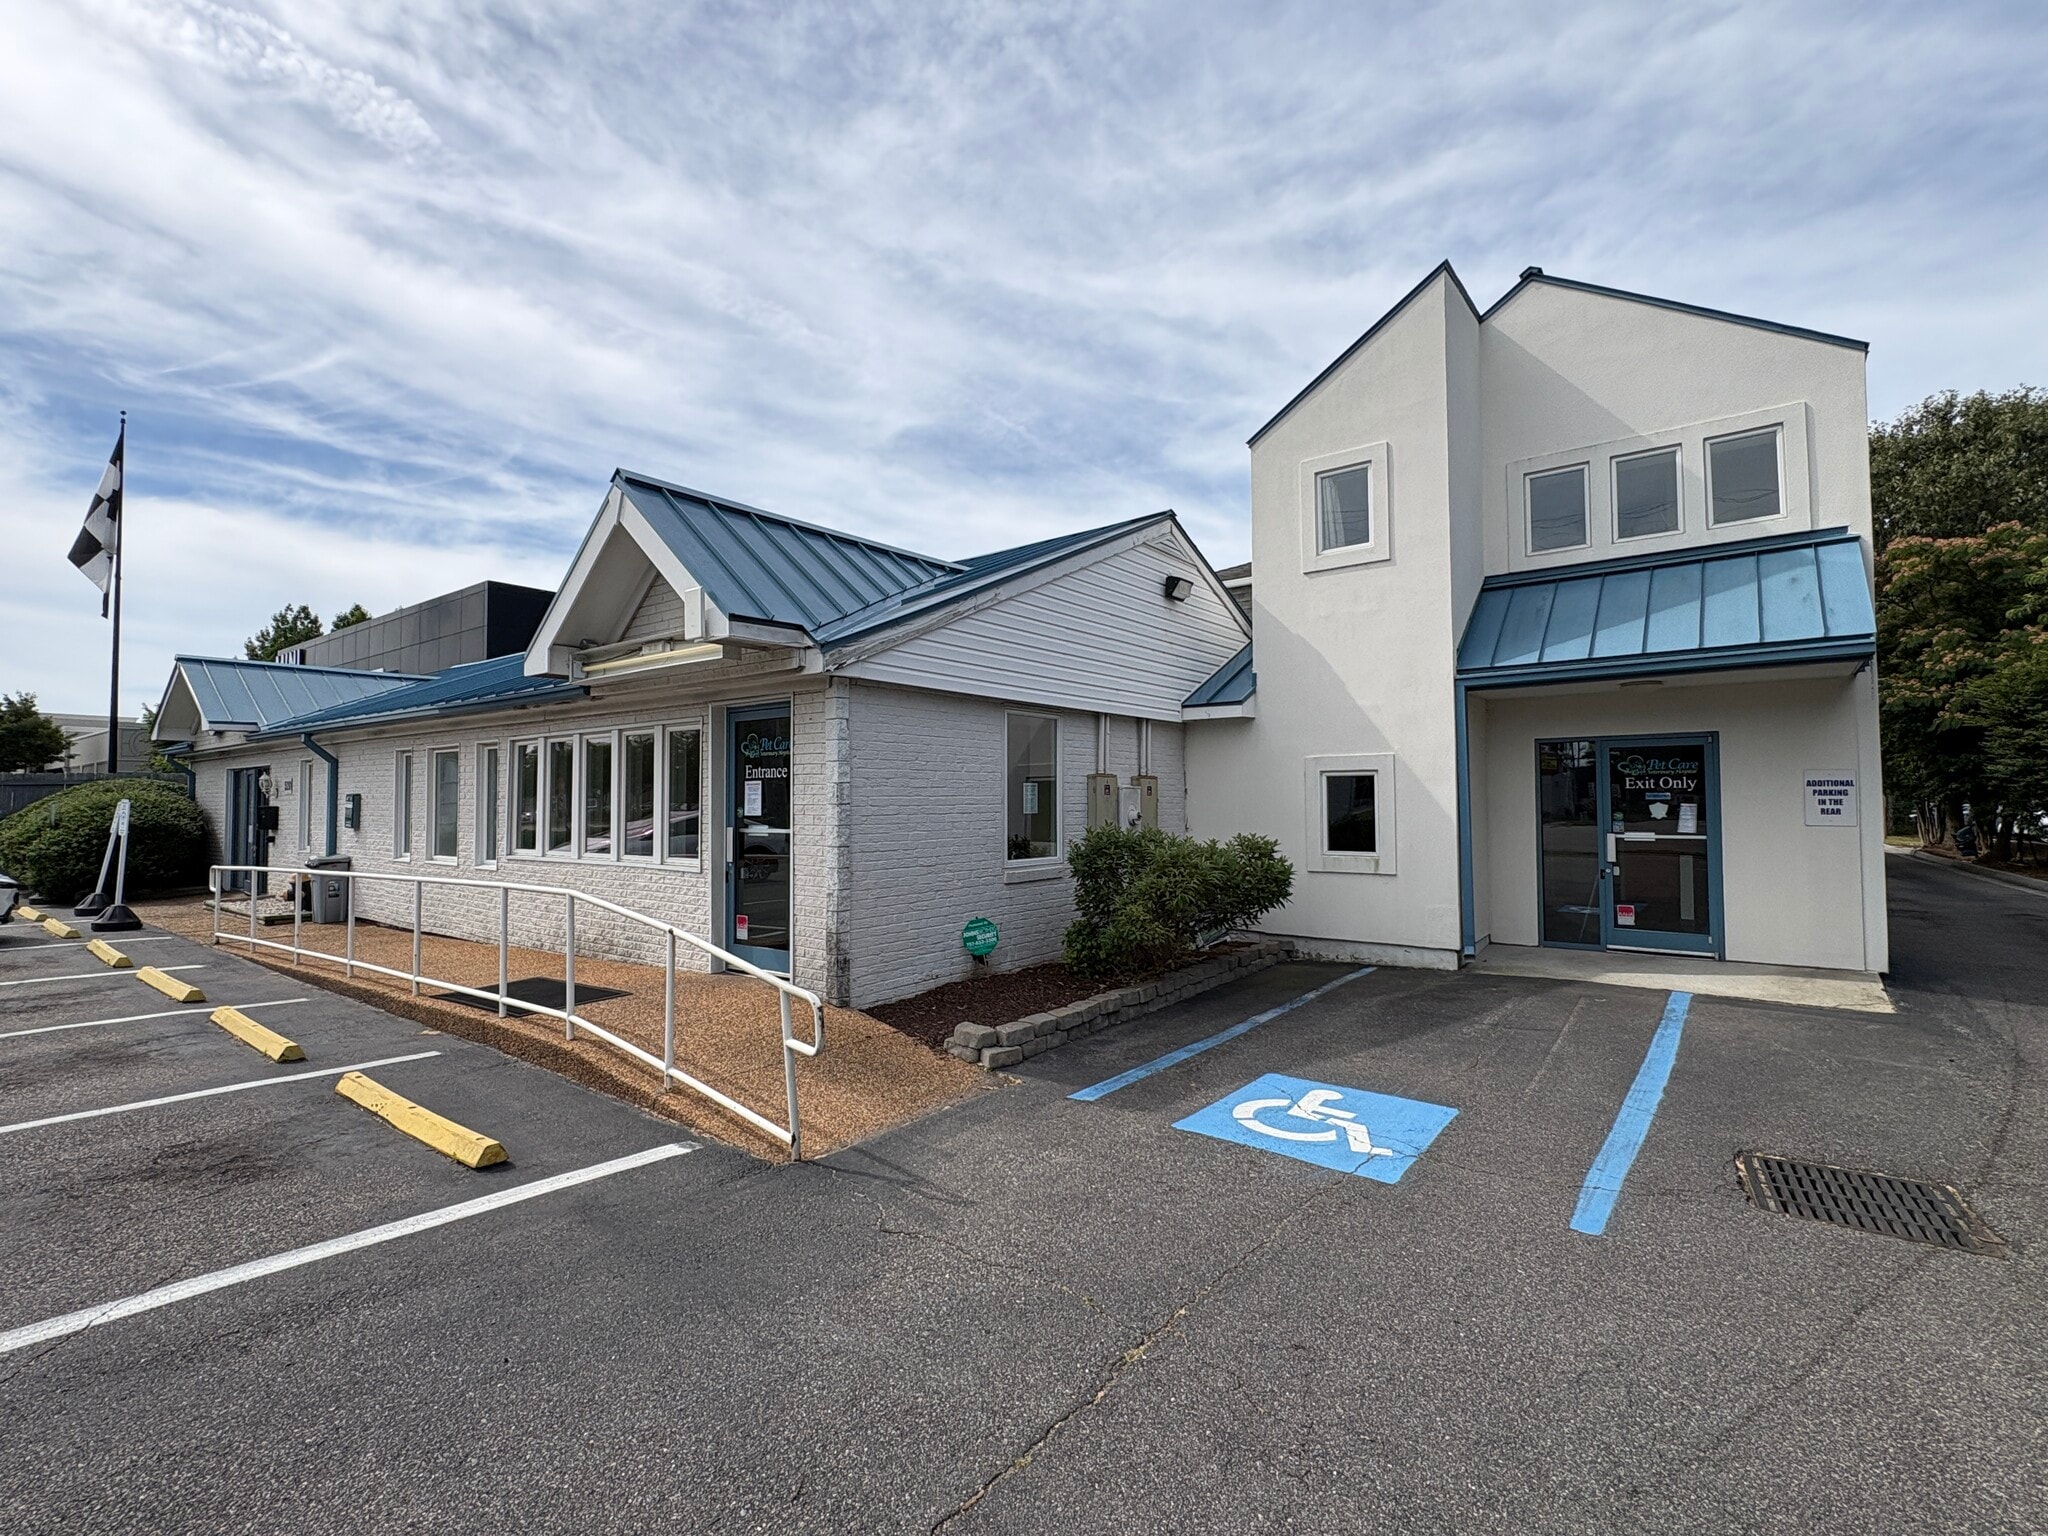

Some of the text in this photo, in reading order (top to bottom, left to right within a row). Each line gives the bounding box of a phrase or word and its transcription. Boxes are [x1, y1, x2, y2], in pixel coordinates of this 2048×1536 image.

[759, 737, 773, 751] Pet
[745, 764, 788, 779] Entrance
[1646, 758, 1699, 771] Pet Care
[1625, 776, 1697, 791] Exit Only
